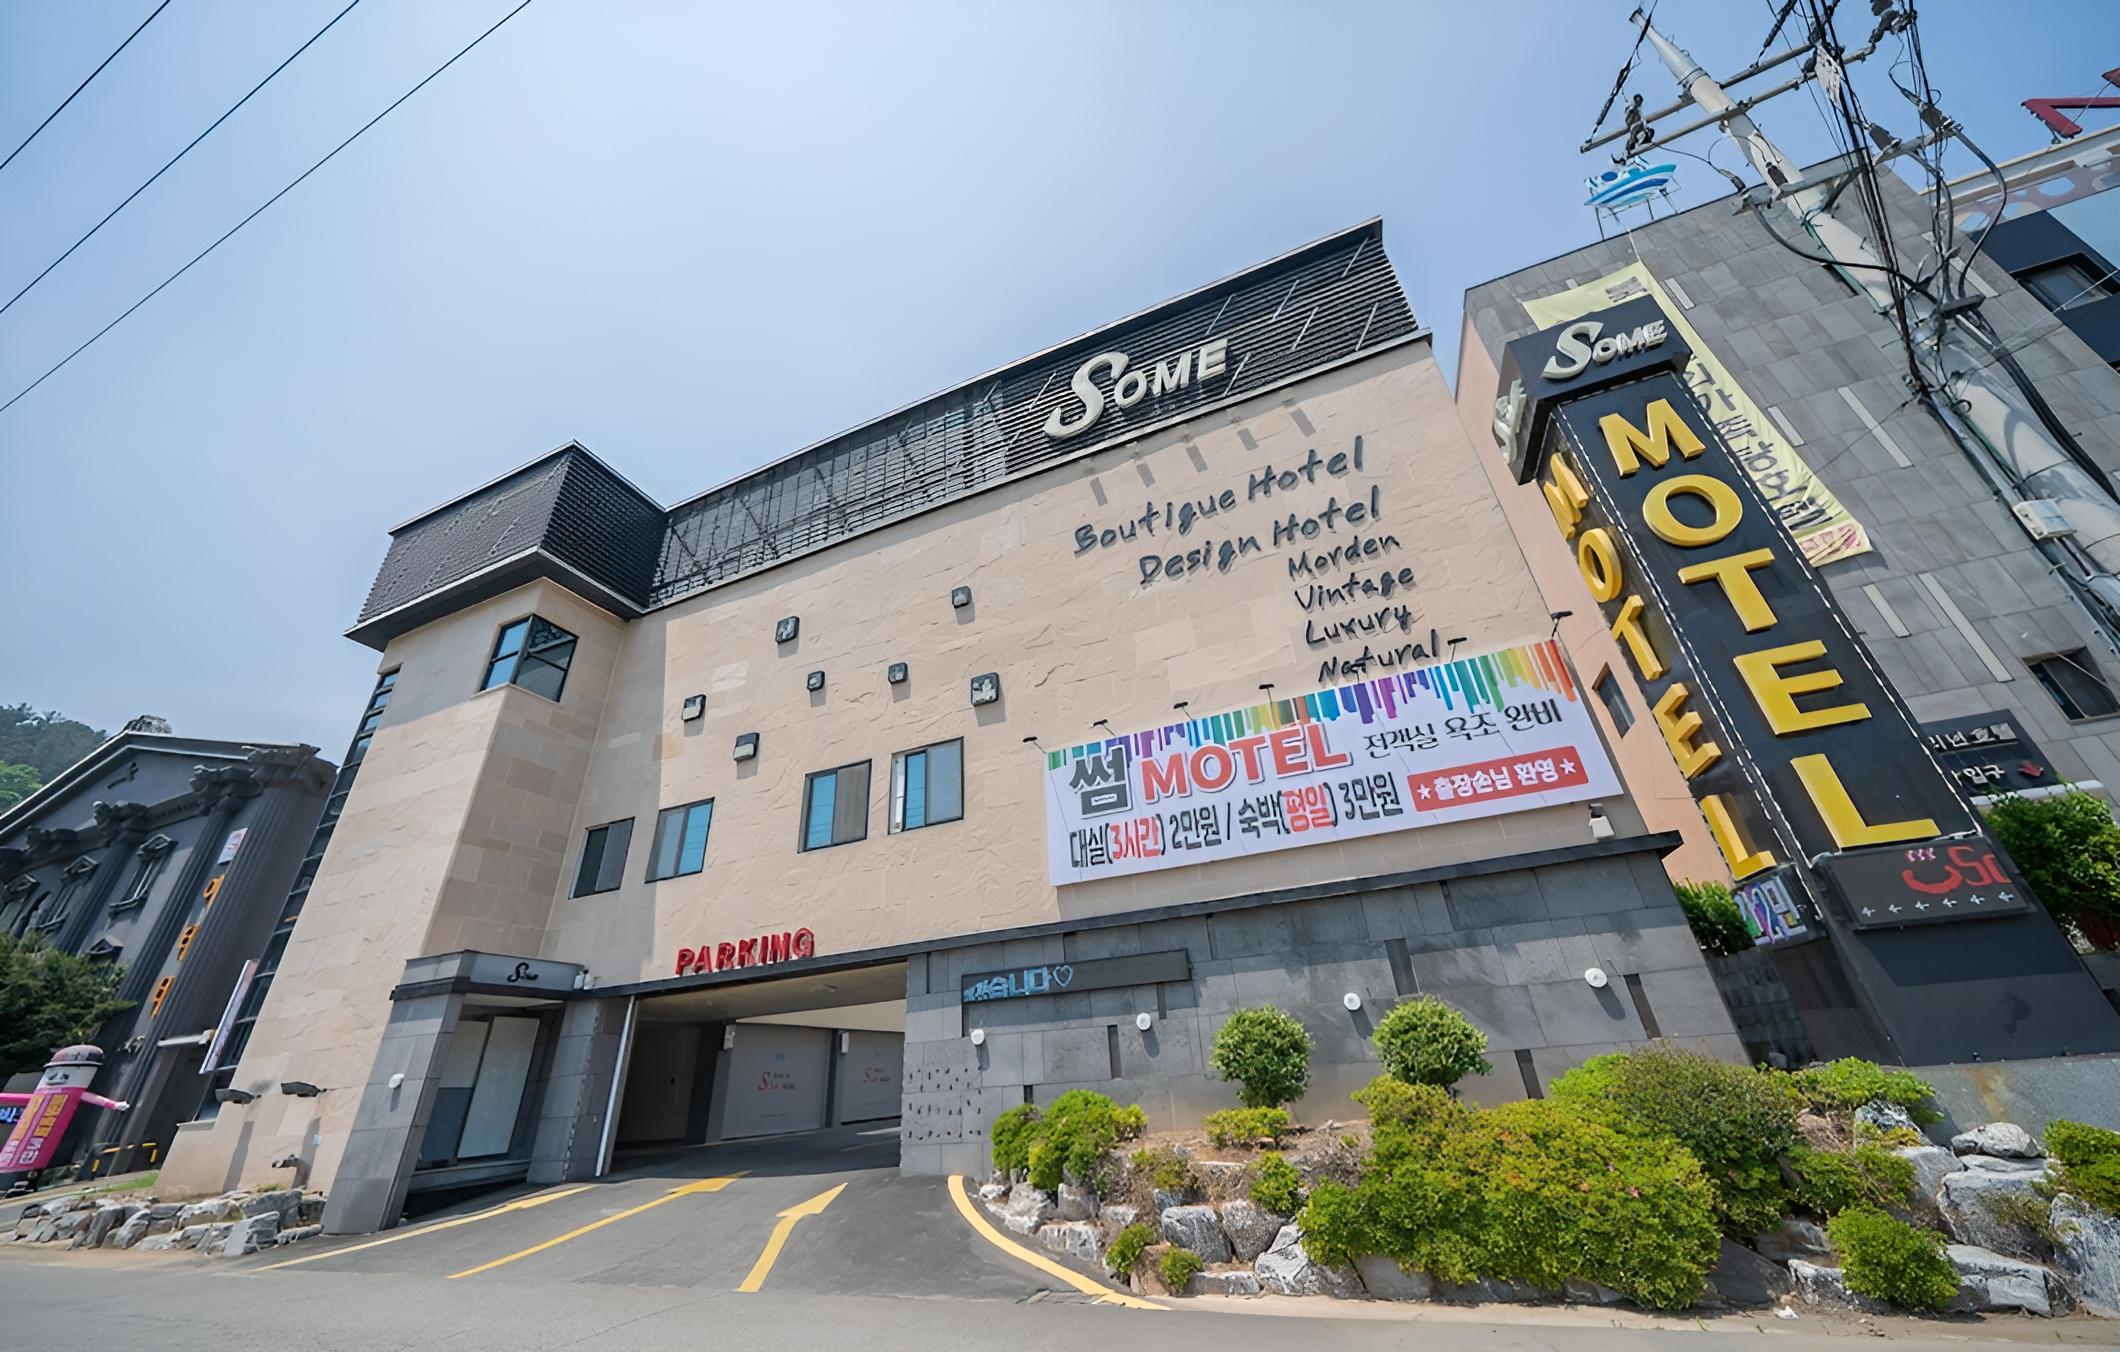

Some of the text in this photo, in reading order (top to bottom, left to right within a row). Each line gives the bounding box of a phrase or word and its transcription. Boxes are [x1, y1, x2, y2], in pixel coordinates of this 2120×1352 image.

[1248, 435, 1364, 500] Hotel
[1139, 484, 1382, 588] Design Hotel
[1288, 535, 1401, 580] Morden
[1294, 568, 1415, 612] Vintage
[1305, 605, 1412, 646] Luxury
[1599, 398, 1942, 850] MOTEL
[1318, 629, 1438, 683] Natural
[1543, 452, 1776, 881] MOTEL
[1363, 722, 1440, 759] 전객실
[1503, 698, 1563, 732] 완비
[1140, 724, 1350, 802] MOTEL
[1168, 803, 1223, 850] 2만원
[1338, 770, 1404, 822] 3만원
[674, 926, 816, 977] PARKING
